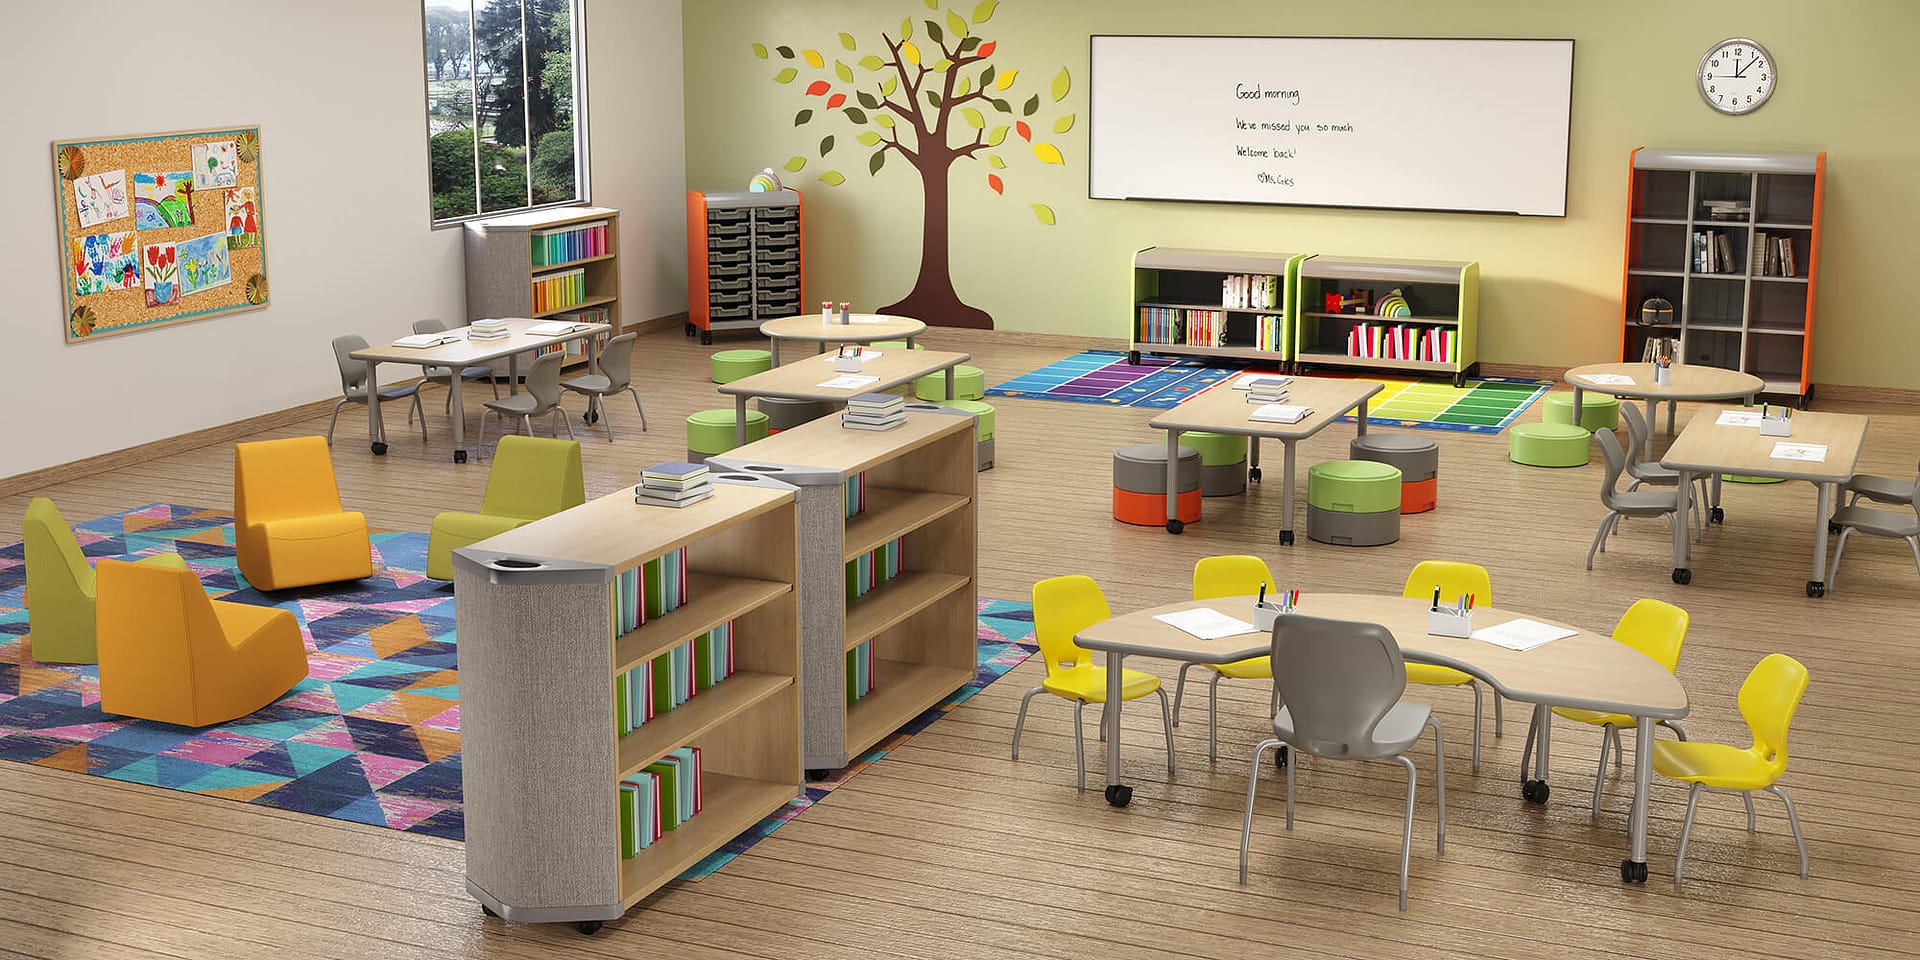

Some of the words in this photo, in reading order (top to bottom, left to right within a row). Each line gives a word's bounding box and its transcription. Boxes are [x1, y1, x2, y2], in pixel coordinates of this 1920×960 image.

[1734, 47, 1743, 56] 12
[1711, 59, 1719, 68] 10
[1758, 60, 1764, 69] 2
[1707, 72, 1713, 80] 9
[1761, 73, 1767, 81] 3
[1709, 85, 1716, 93] 8
[1235, 83, 1261, 100] Good
[1264, 90, 1301, 106] morning
[1718, 94, 1723, 103] 7
[1746, 95, 1752, 103] 5
[1732, 97, 1738, 105] 6
[1261, 120, 1291, 132] missed
[1295, 125, 1311, 135] you
[1316, 124, 1329, 132] so
[1331, 123, 1354, 133] much
[1236, 145, 1269, 158] Welcome
[1272, 147, 1297, 159] back!
